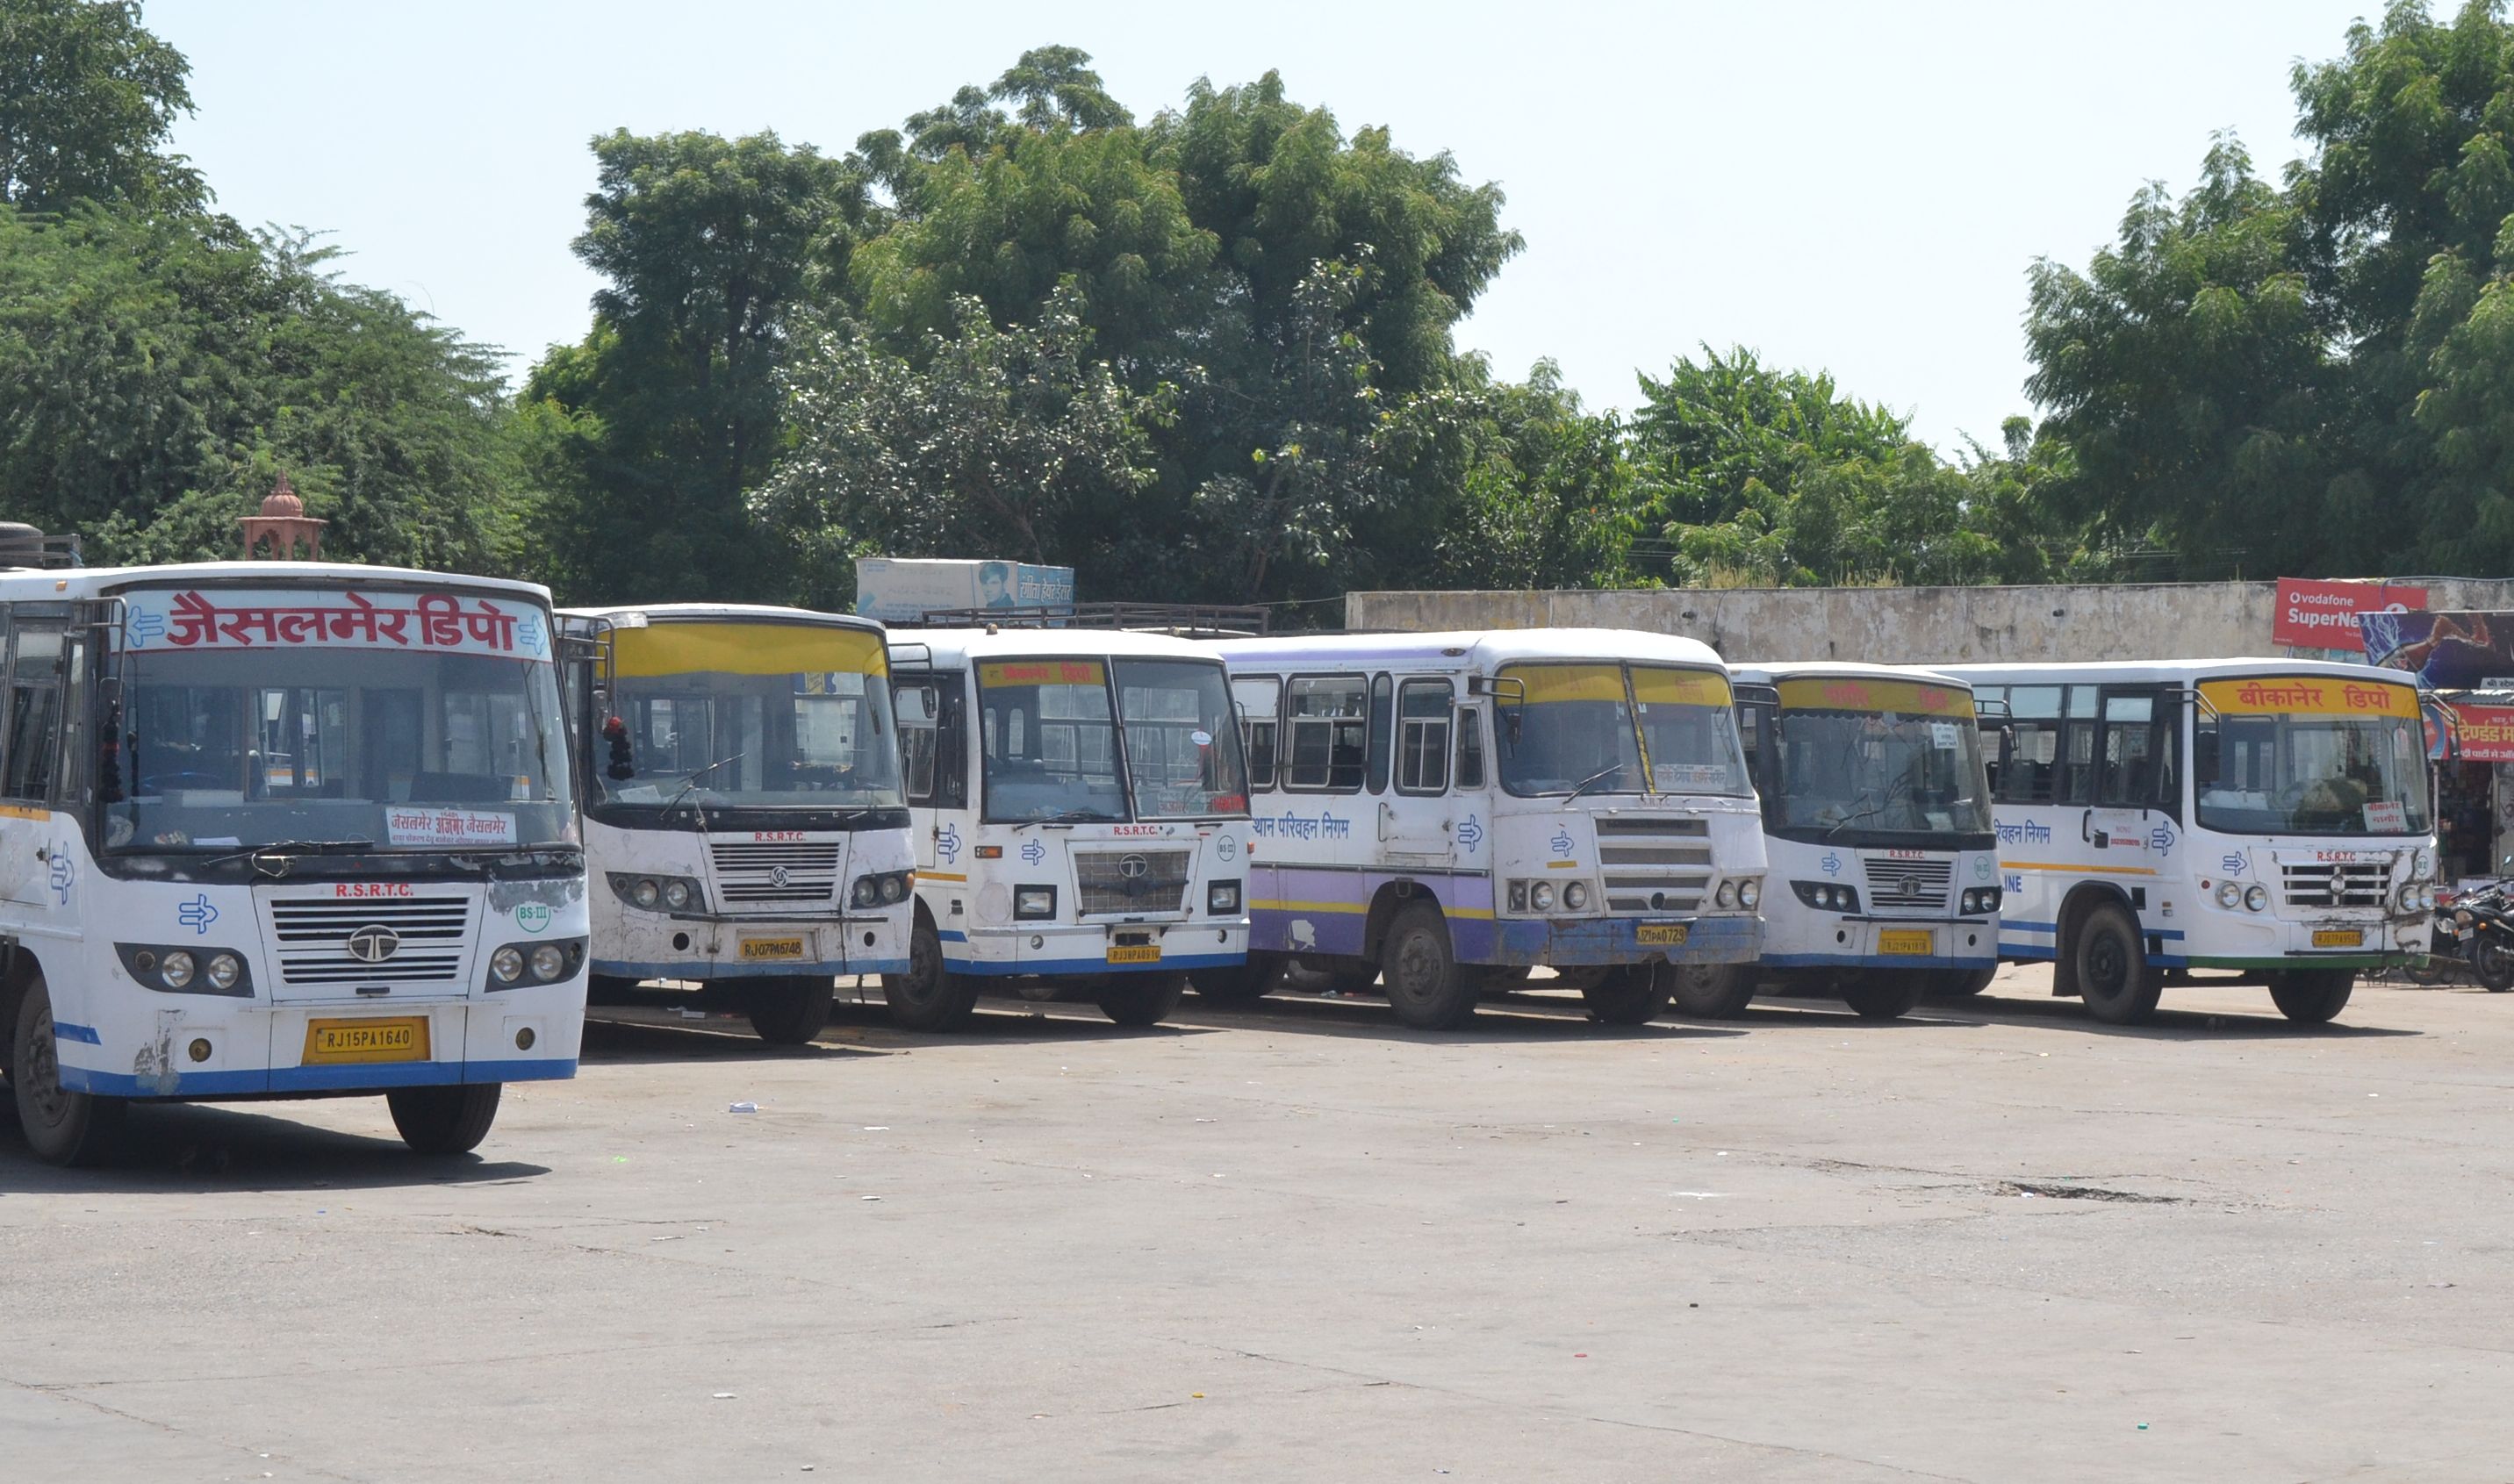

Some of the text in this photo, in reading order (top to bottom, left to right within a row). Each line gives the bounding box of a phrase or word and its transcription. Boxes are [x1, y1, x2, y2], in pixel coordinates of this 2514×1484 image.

[2302, 594, 2354, 607] vodafone
[167, 590, 518, 651] जैसलमेर डिपो
[2237, 682, 2390, 709] बीकानेर डिपो
[466, 813, 506, 835] जैसलमेर
[1114, 826, 1158, 835] R.S.R.T.C.
[1278, 810, 1318, 840] परिवहन
[1322, 811, 1350, 839] निगम
[2025, 819, 2051, 844] निगम
[755, 831, 807, 842] R.S.R.T.C.
[335, 884, 413, 897] R.S.R.T.C.
[2001, 876, 2022, 893] INE
[327, 1029, 410, 1048] RJ15PA1640
